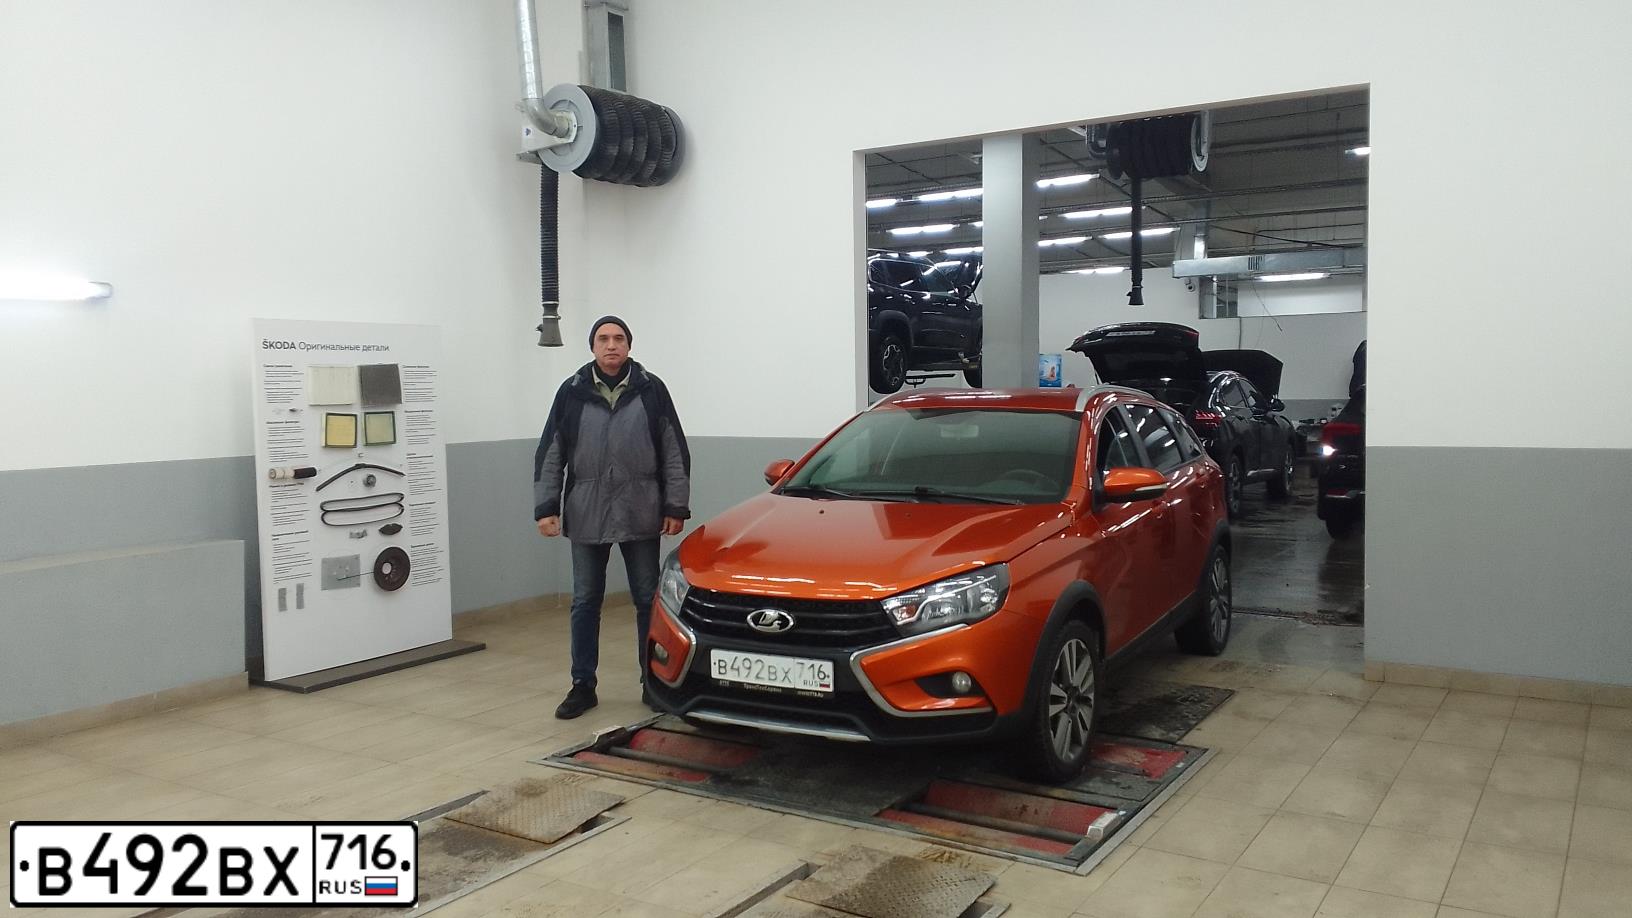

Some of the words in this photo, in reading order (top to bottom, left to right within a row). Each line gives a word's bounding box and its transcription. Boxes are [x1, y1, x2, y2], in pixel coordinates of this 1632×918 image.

[262, 338, 297, 350] ŠKODA
[298, 341, 361, 352] Оригинальные
[361, 344, 390, 352] детали
[717, 656, 793, 684] В492ВХ
[796, 661, 827, 681] 716
[803, 679, 819, 688] RUS
